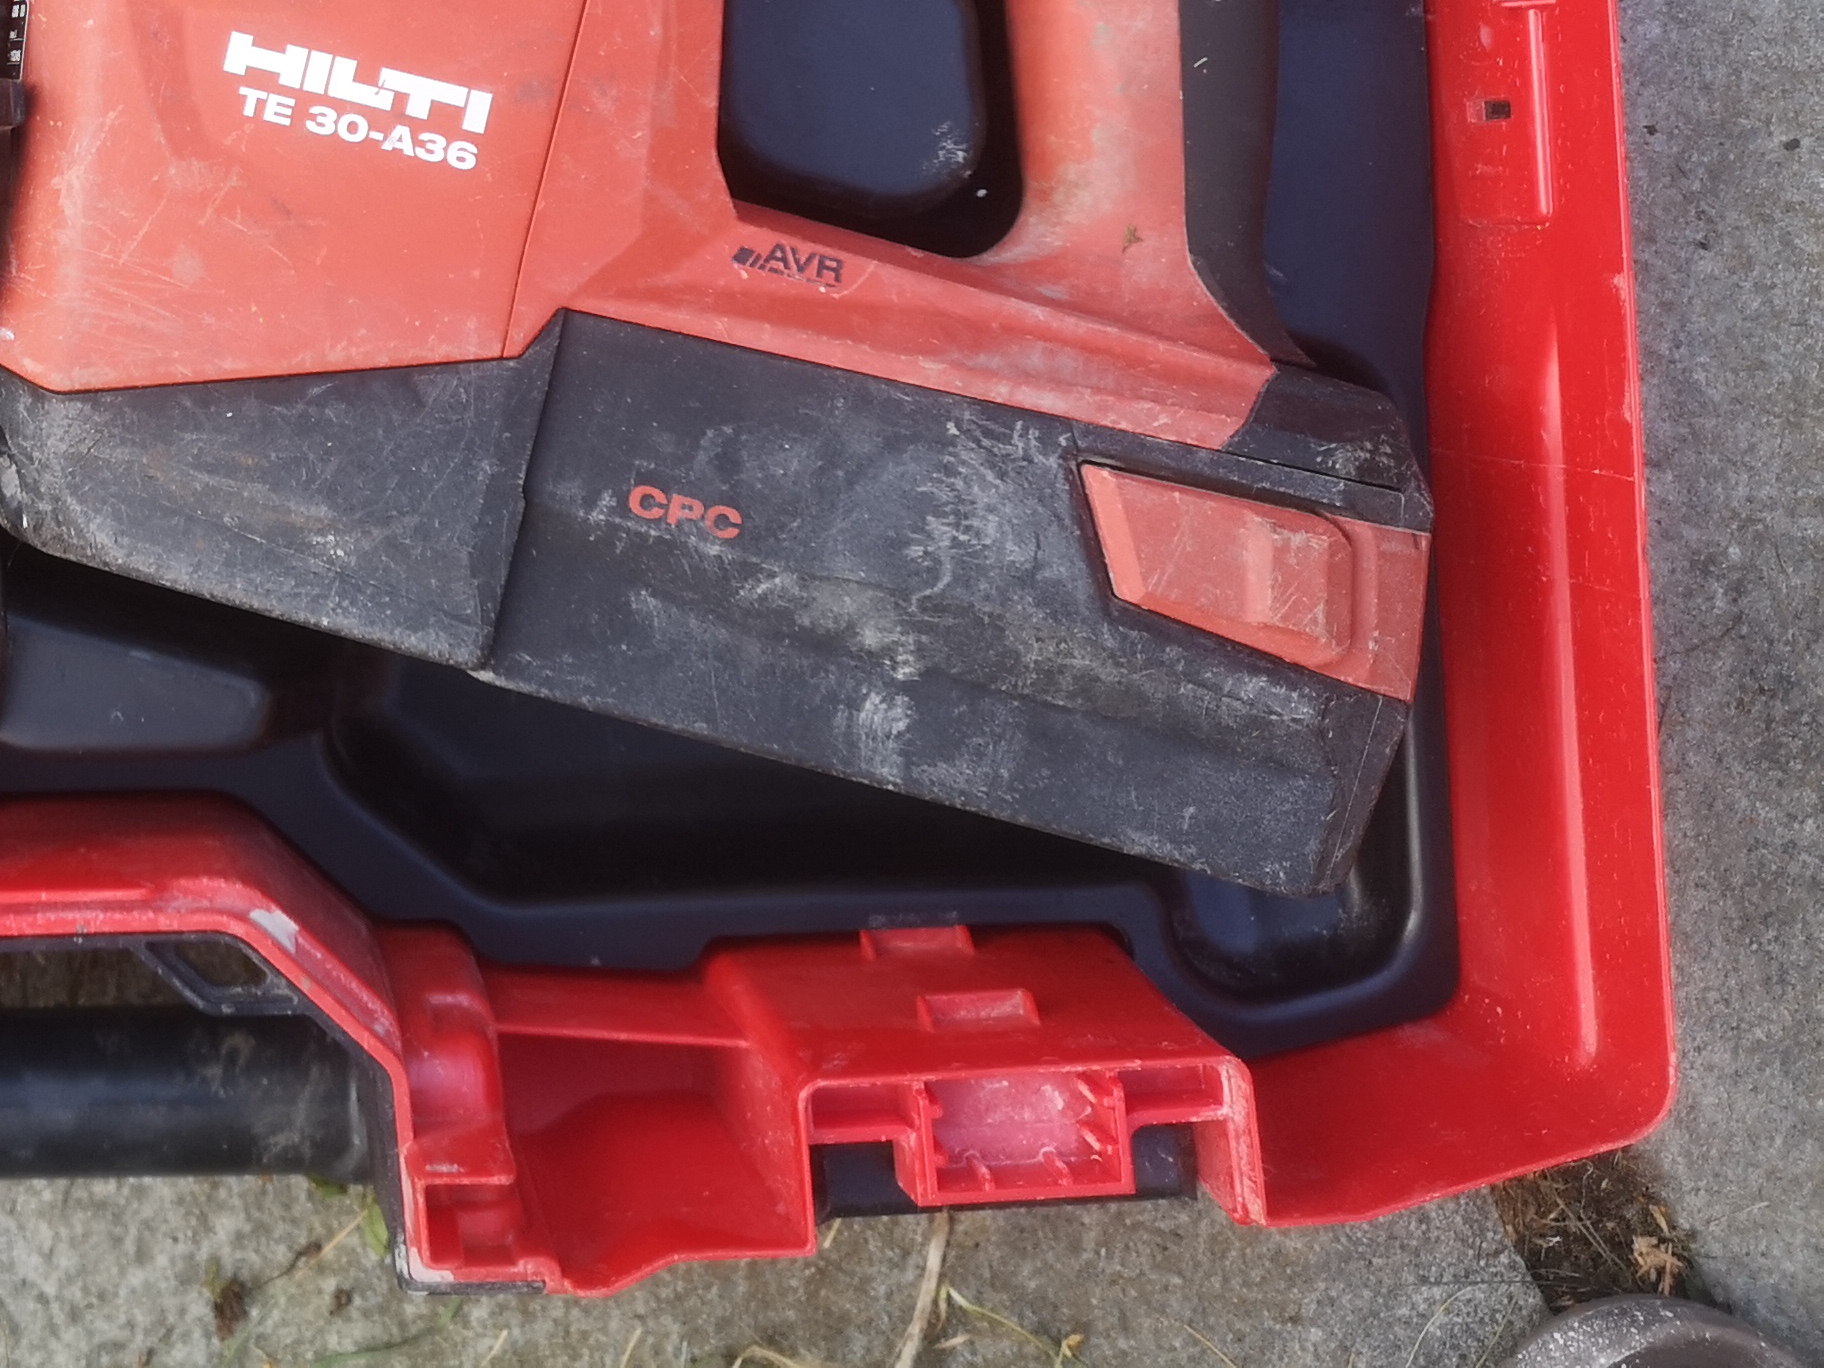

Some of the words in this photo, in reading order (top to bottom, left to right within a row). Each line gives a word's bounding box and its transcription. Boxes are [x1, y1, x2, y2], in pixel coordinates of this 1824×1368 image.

[223, 30, 493, 134] HILTI
[239, 86, 296, 127] TE
[305, 105, 478, 171] 30-A36
[763, 243, 844, 284] AVR
[628, 484, 743, 539] CPC
